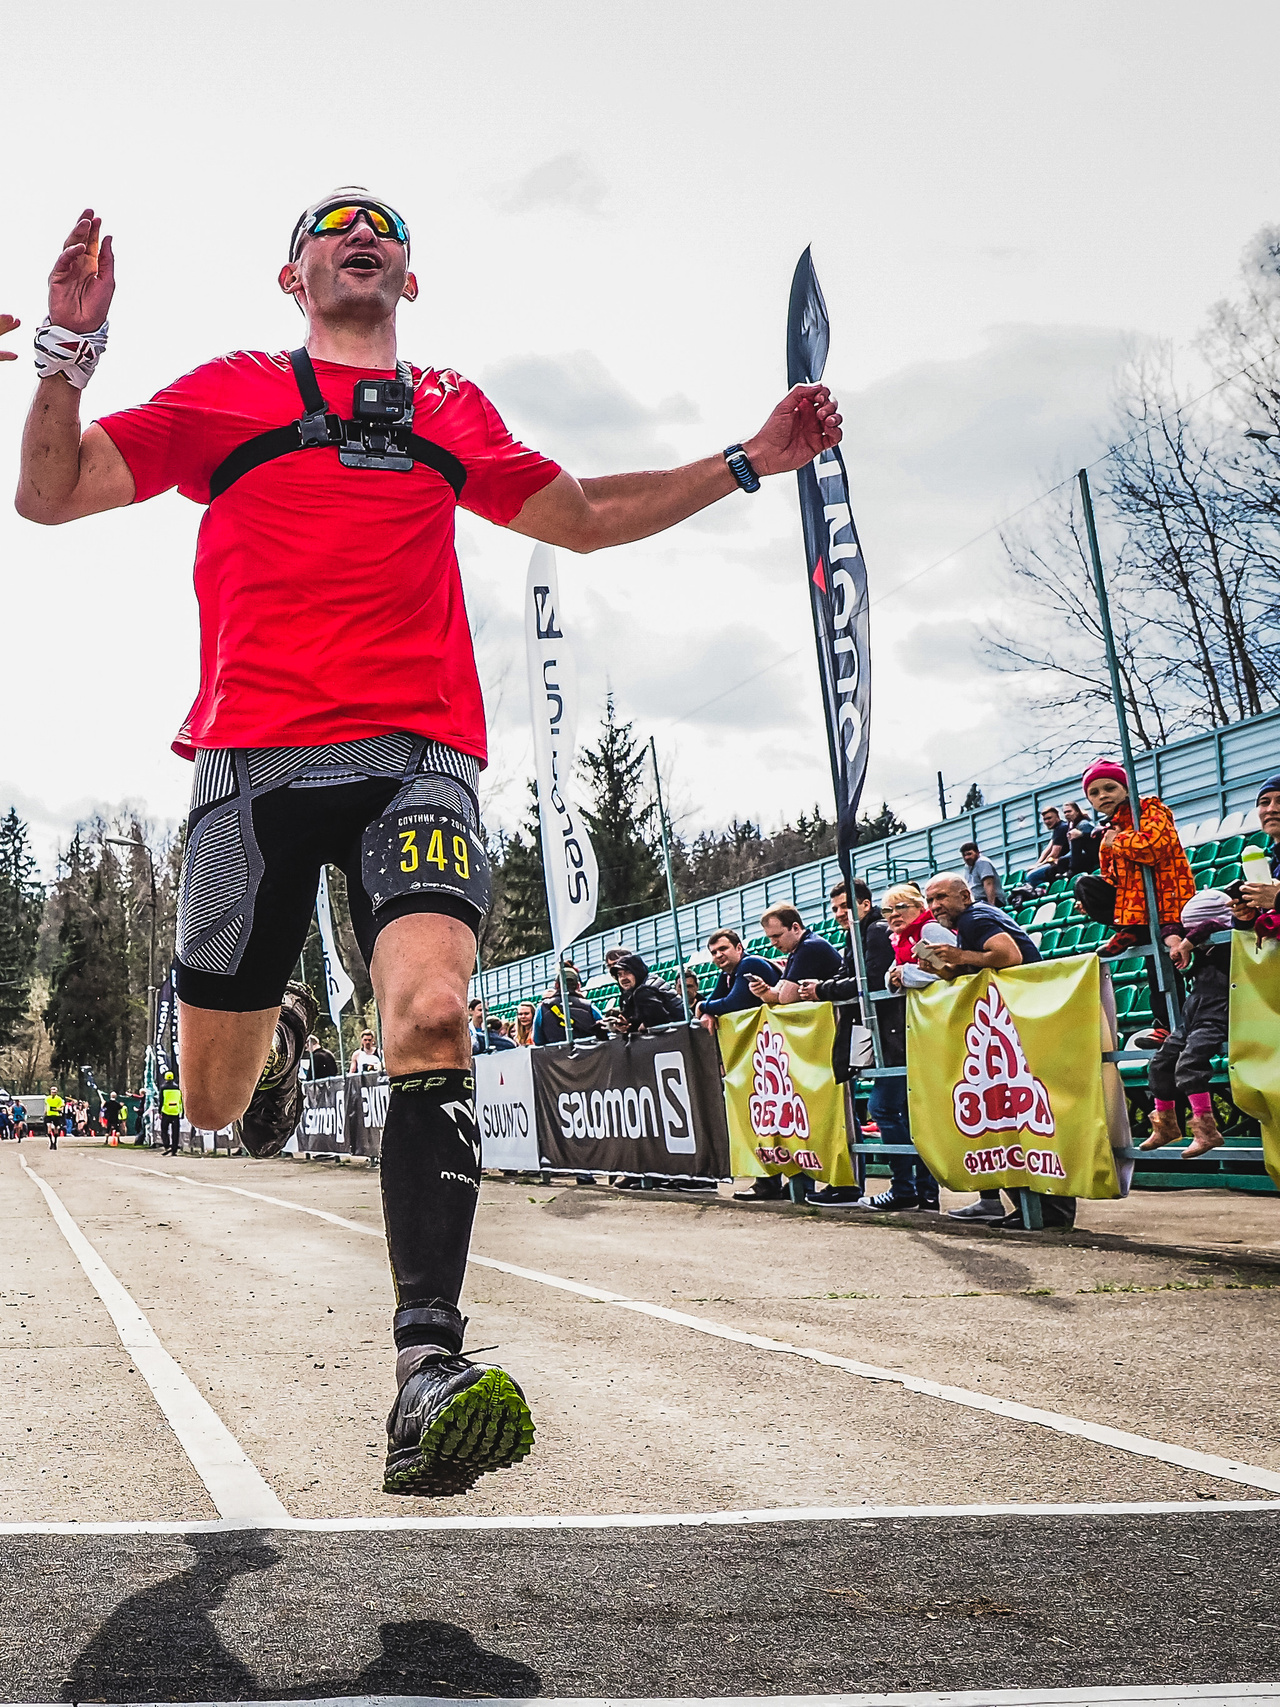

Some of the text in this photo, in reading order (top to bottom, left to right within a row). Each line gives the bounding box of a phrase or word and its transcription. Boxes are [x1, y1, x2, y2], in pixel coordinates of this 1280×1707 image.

[398, 813, 435, 827] СПУТНИК
[399, 829, 471, 880] 349
[483, 1101, 529, 1139] SUUNTO
[558, 1085, 660, 1140] salomon
